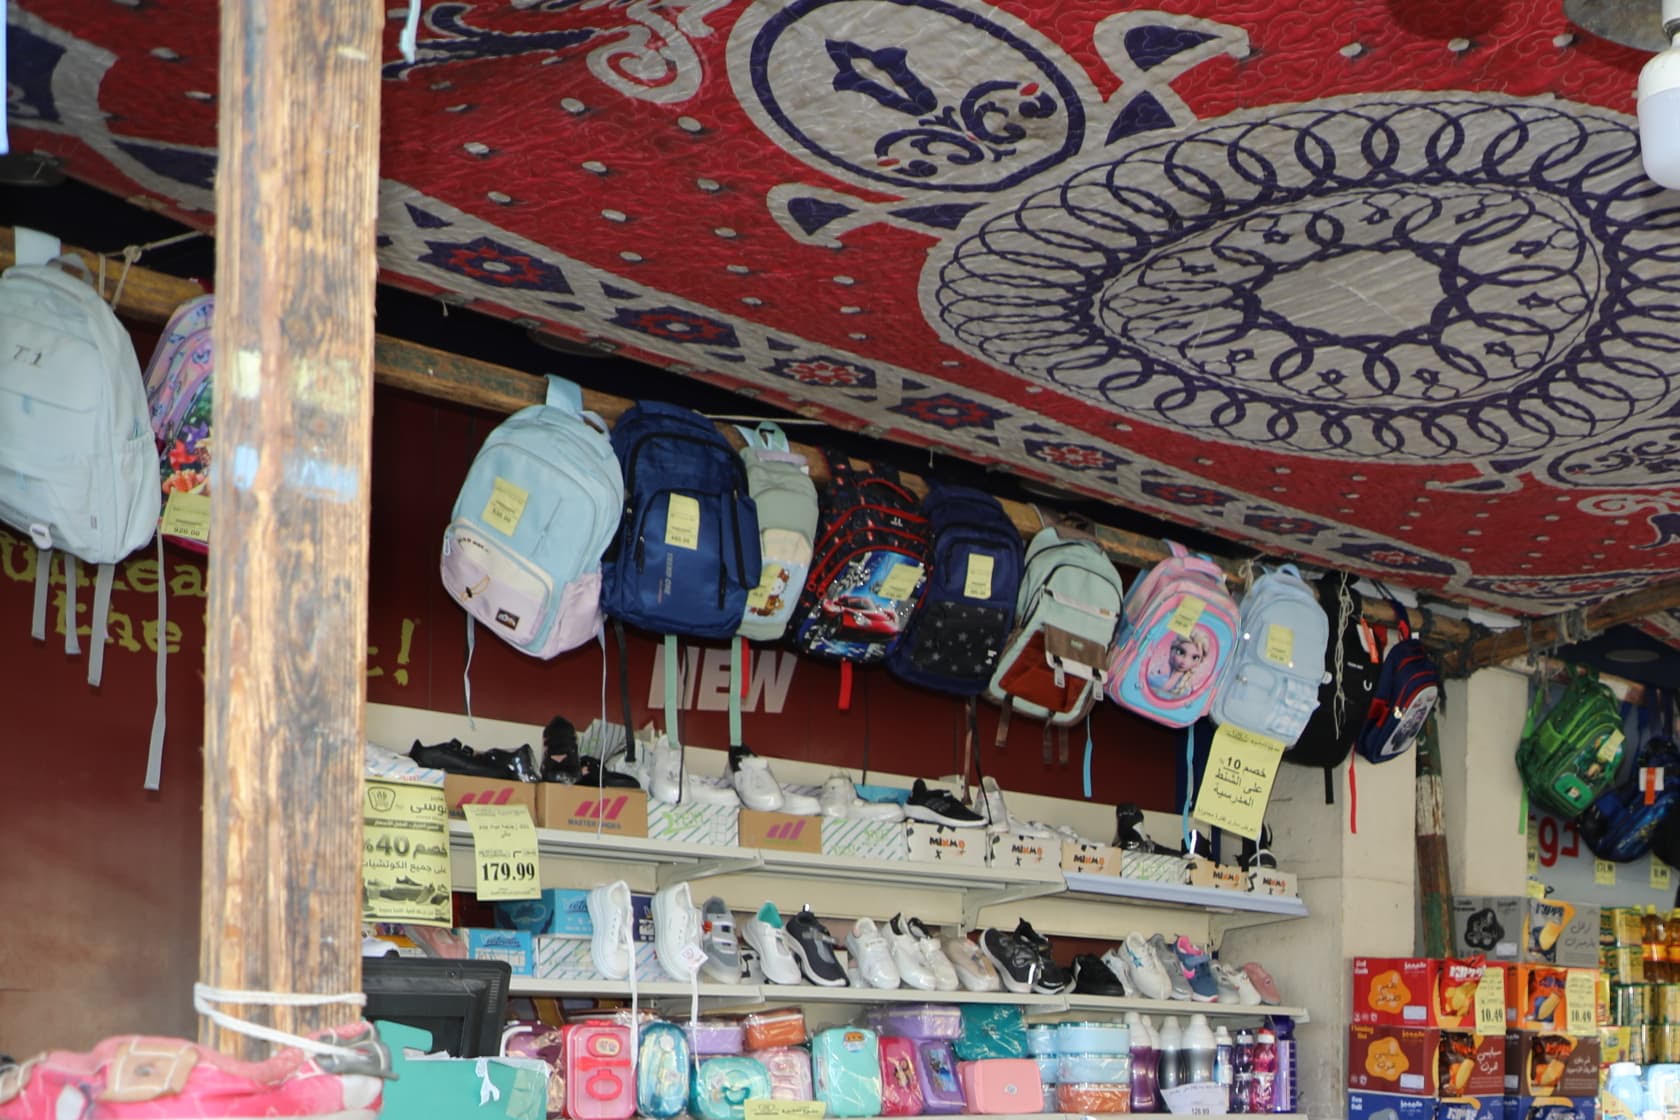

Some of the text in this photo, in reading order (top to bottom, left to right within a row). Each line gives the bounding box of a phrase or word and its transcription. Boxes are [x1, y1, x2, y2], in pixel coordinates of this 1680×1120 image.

[648, 644, 797, 713] NEW
[364, 859, 408, 871] الكوتشيا
[482, 861, 535, 882] 179.99
